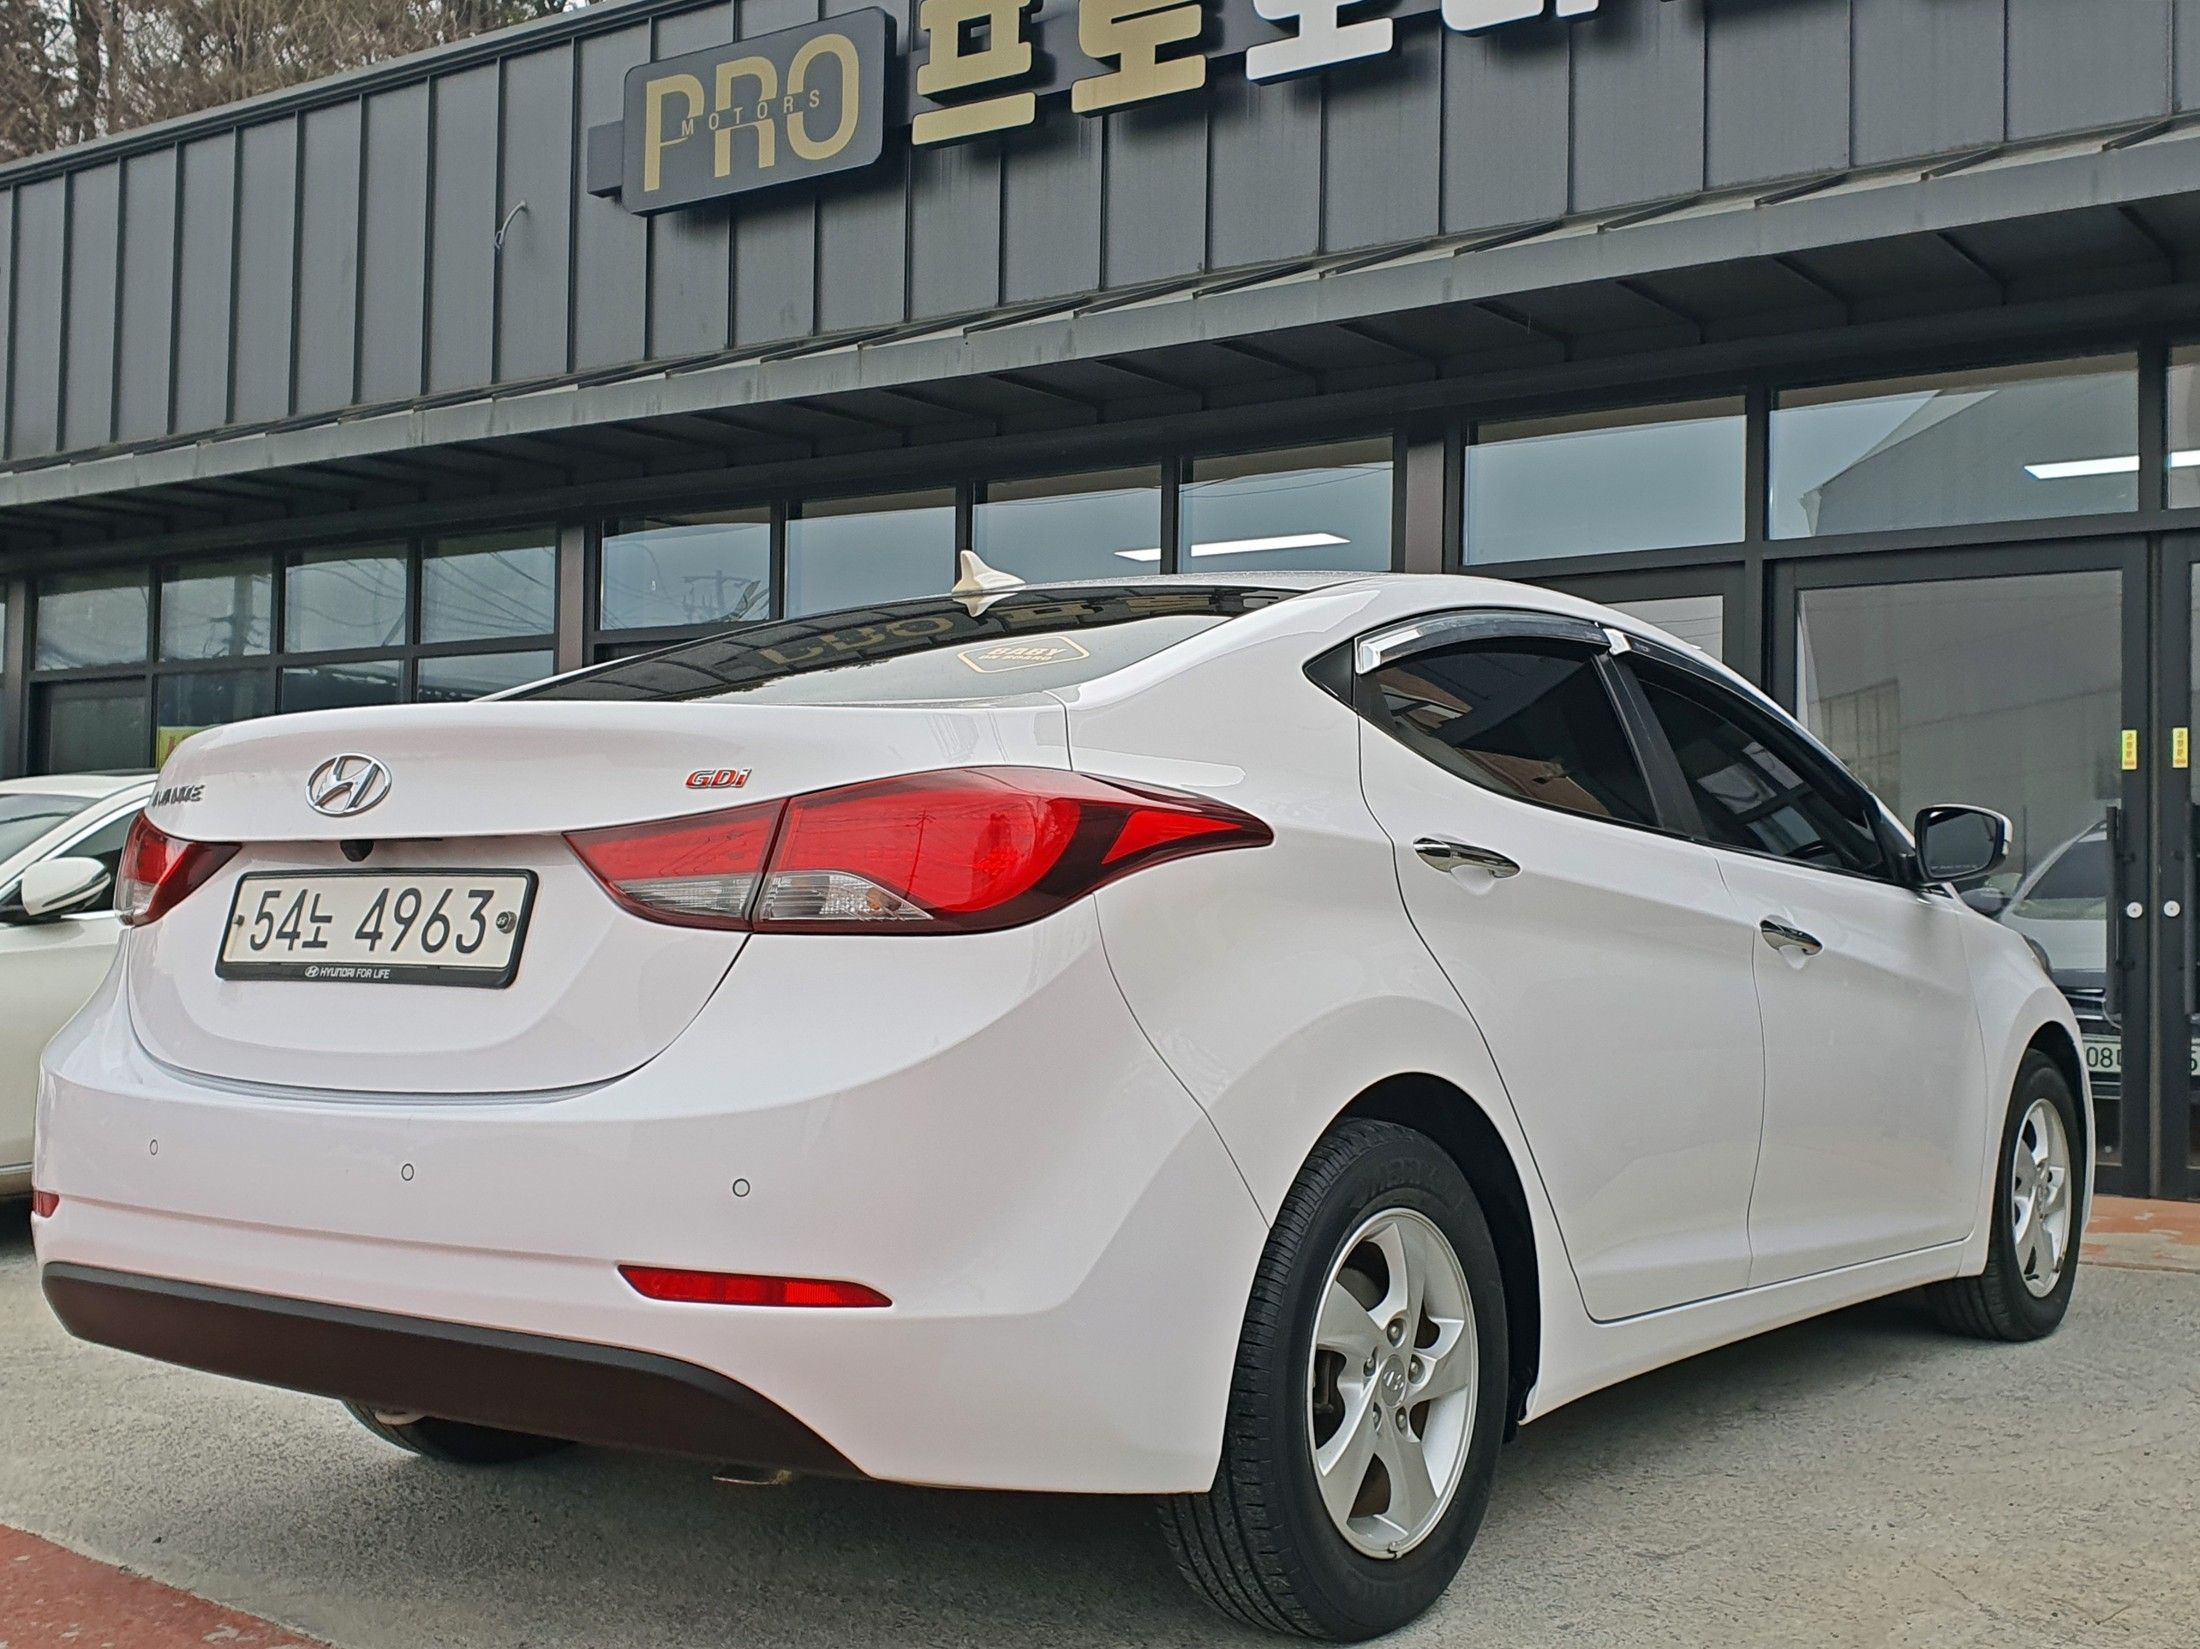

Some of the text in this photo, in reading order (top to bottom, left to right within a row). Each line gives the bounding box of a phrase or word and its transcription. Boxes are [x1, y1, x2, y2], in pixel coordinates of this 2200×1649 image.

[643, 33, 860, 193] PRO
[681, 89, 821, 138] MOTORS
[987, 647, 1067, 656] BABY
[249, 887, 496, 955] 54노 4963
[320, 967, 391, 979] HYUNDAI FOR LIFE
[2086, 1046, 2121, 1069] 08
